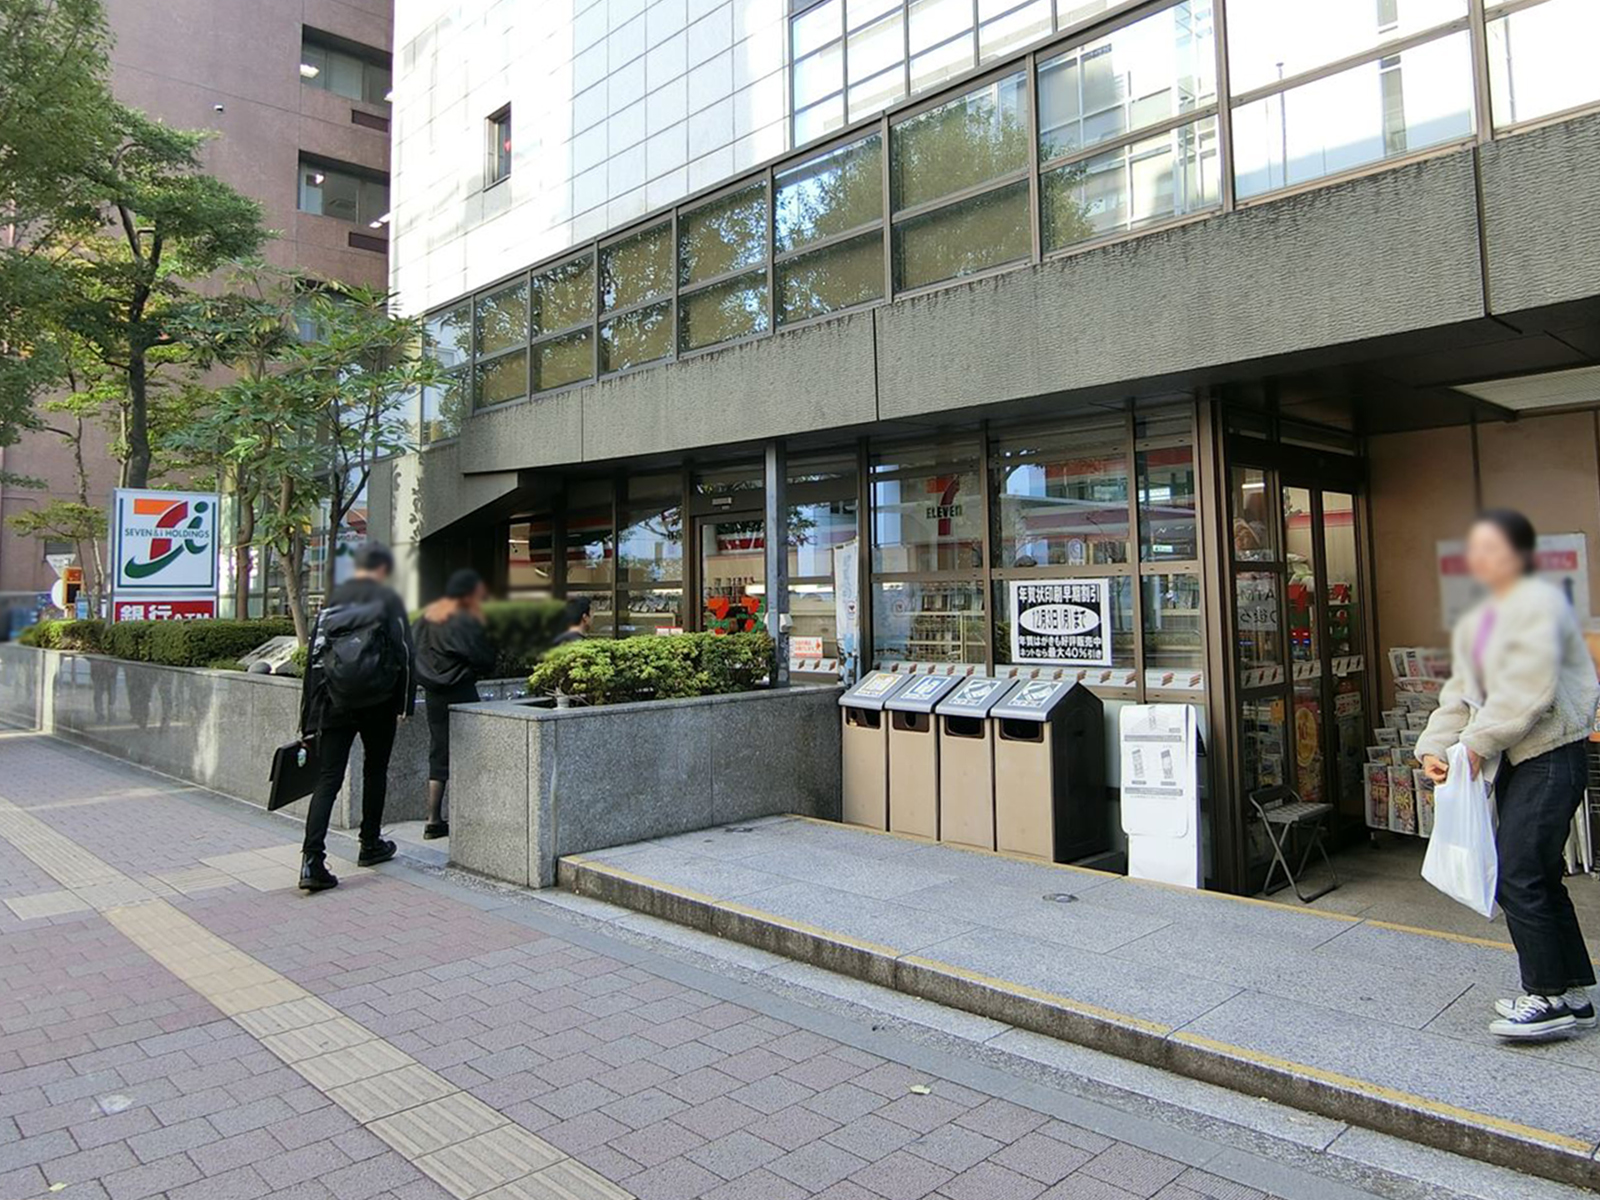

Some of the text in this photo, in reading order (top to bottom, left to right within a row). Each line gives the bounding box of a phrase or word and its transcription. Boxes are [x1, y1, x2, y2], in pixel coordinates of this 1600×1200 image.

[125, 528, 153, 537] SEVEN
[165, 529, 210, 538] HOLDINGS
[1019, 584, 1100, 603] 年賀状印刷早期割引
